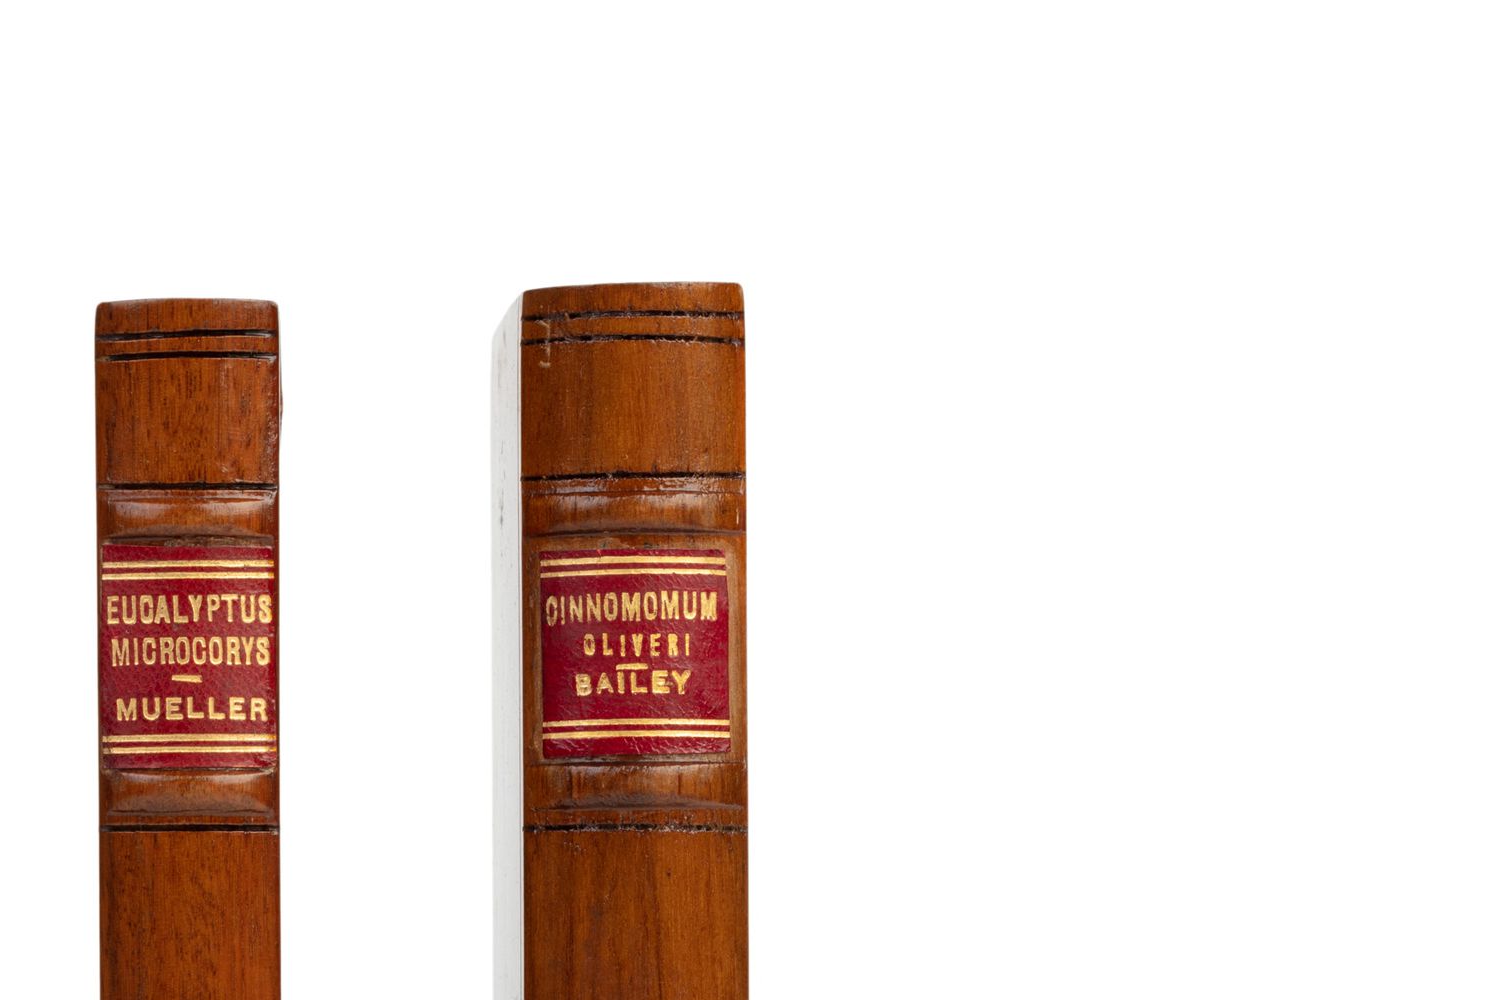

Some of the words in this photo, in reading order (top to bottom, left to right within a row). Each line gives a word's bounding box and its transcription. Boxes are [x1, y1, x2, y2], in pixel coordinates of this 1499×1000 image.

[106, 593, 273, 626] EUCALYPTUS
[546, 590, 718, 626] CINNOMOMUM
[111, 635, 272, 667] MICROCORYS
[583, 632, 691, 658] OLIVERI
[575, 669, 693, 697] BAILEY
[116, 696, 269, 722] MUELLER
